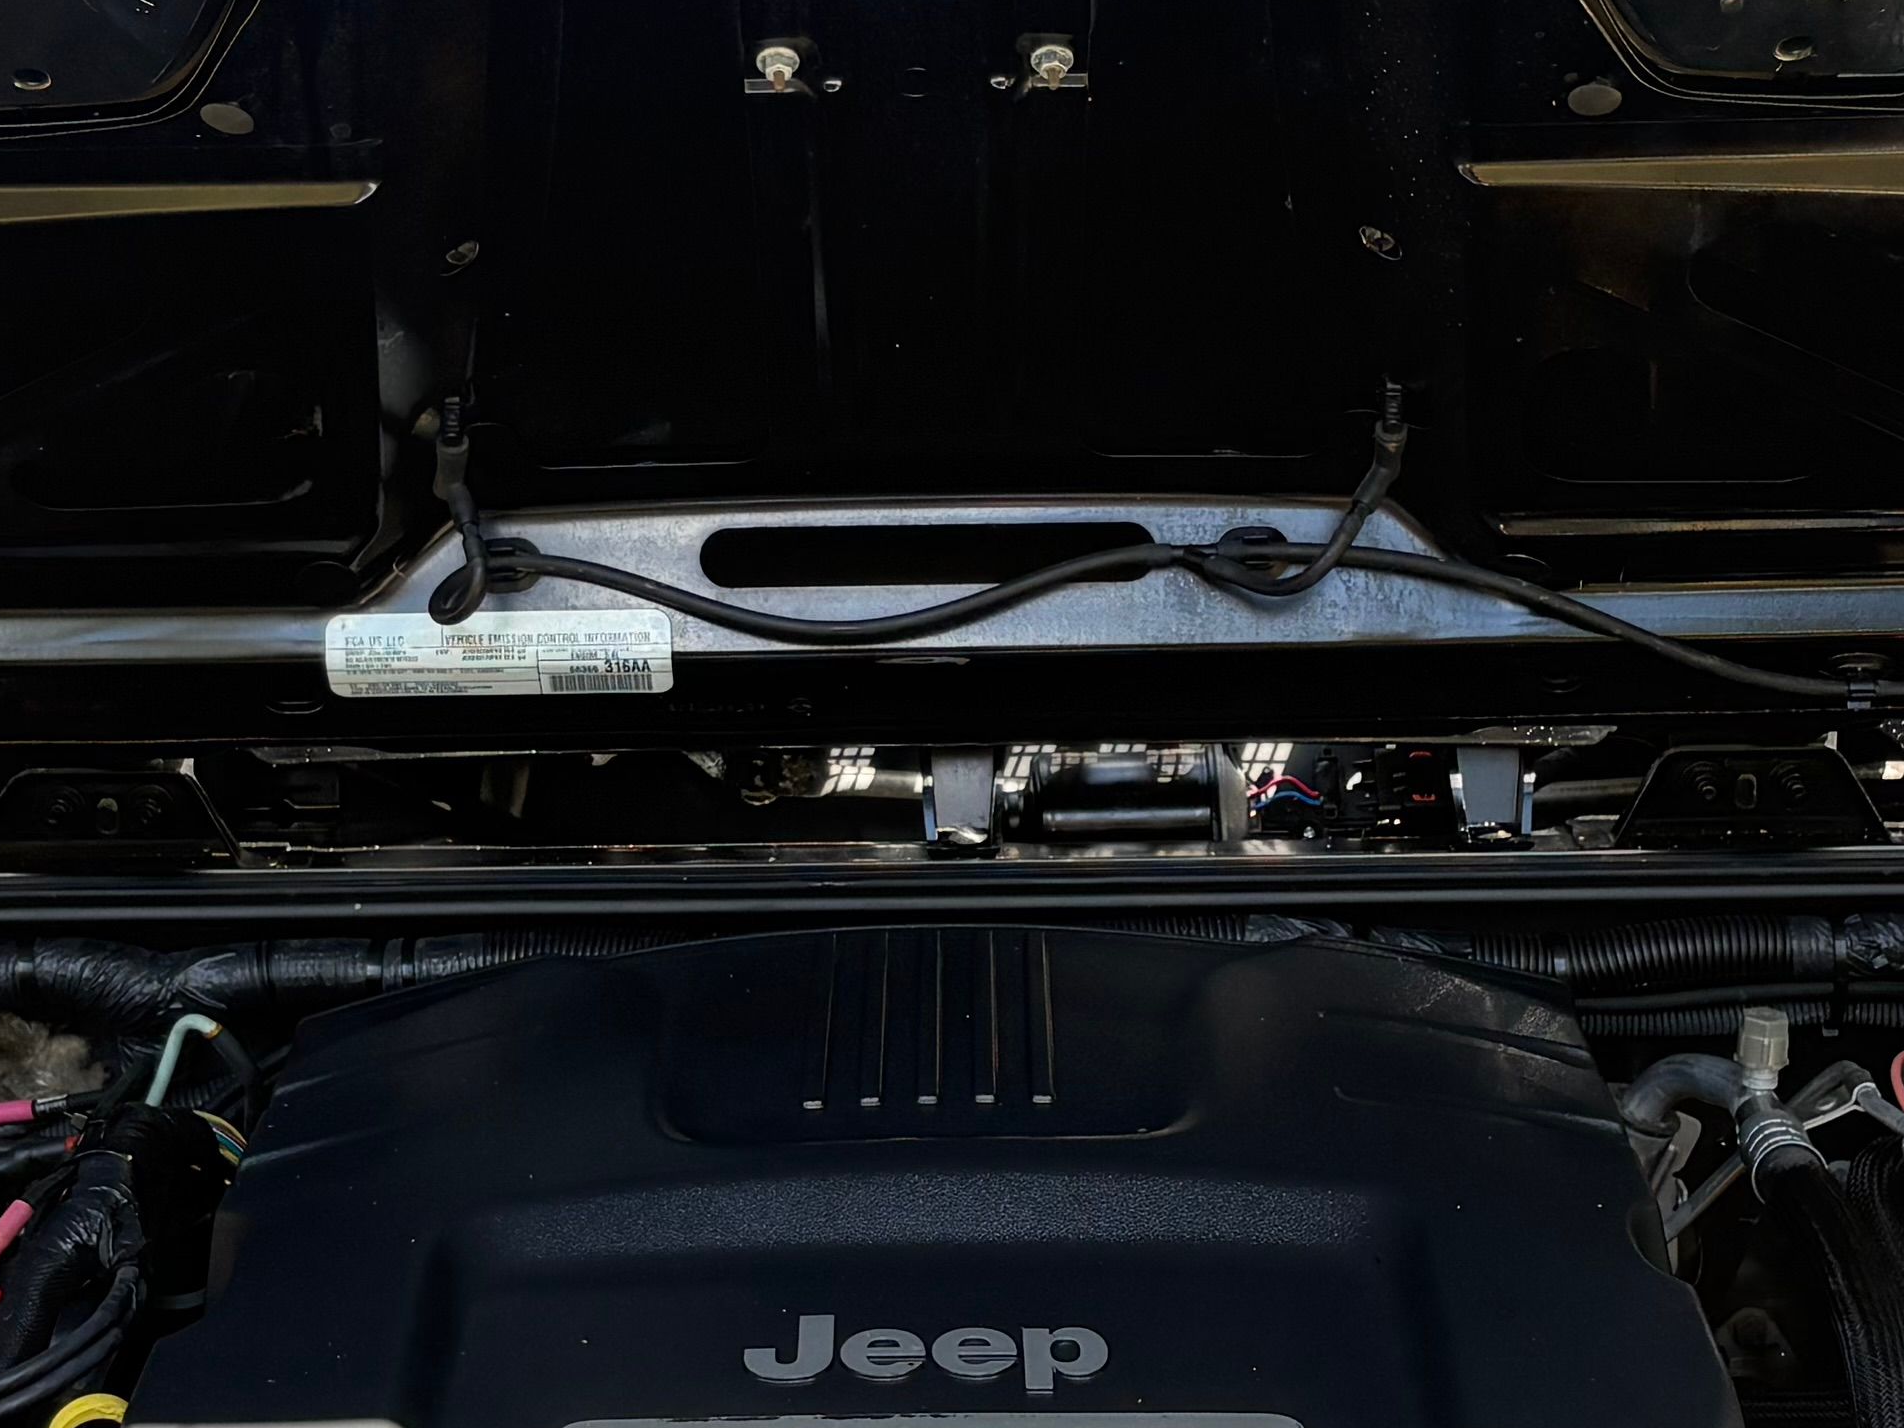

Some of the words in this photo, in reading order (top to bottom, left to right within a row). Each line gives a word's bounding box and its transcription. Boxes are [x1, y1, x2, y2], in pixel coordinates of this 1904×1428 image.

[445, 634, 484, 647] VEHICLE
[488, 633, 534, 646] EMISSION
[537, 632, 580, 644] CONTROL
[584, 631, 651, 643] INFORMATION
[604, 659, 652, 673] 316AA
[743, 1314, 1109, 1394] Jeep
